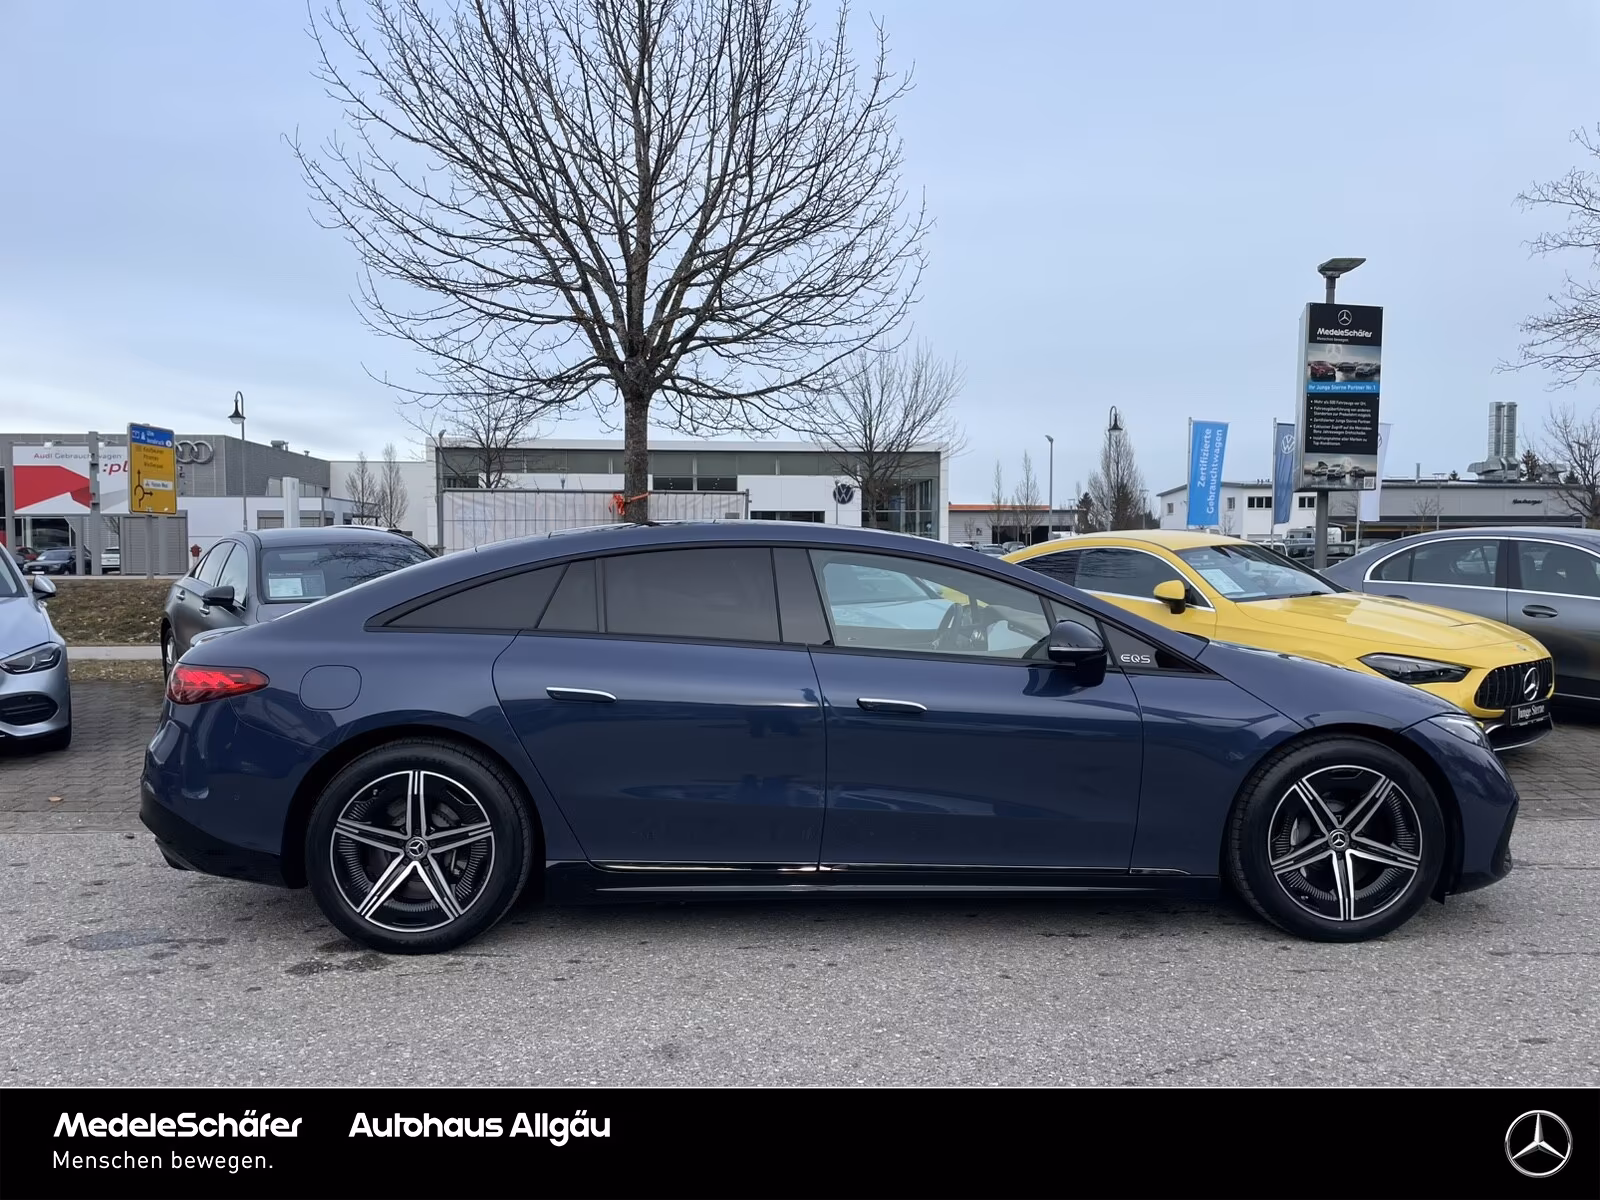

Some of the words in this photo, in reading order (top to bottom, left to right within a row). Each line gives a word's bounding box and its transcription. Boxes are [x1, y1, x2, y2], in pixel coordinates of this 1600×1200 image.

[1316, 327, 1373, 338] MedeleSchäfer
[1197, 428, 1212, 488] Zertifizierte
[1206, 429, 1223, 514] Gebrauchtwagen
[1120, 653, 1151, 664] EQS
[1517, 707, 1532, 720] Junge
[1531, 704, 1545, 716] Sterne
